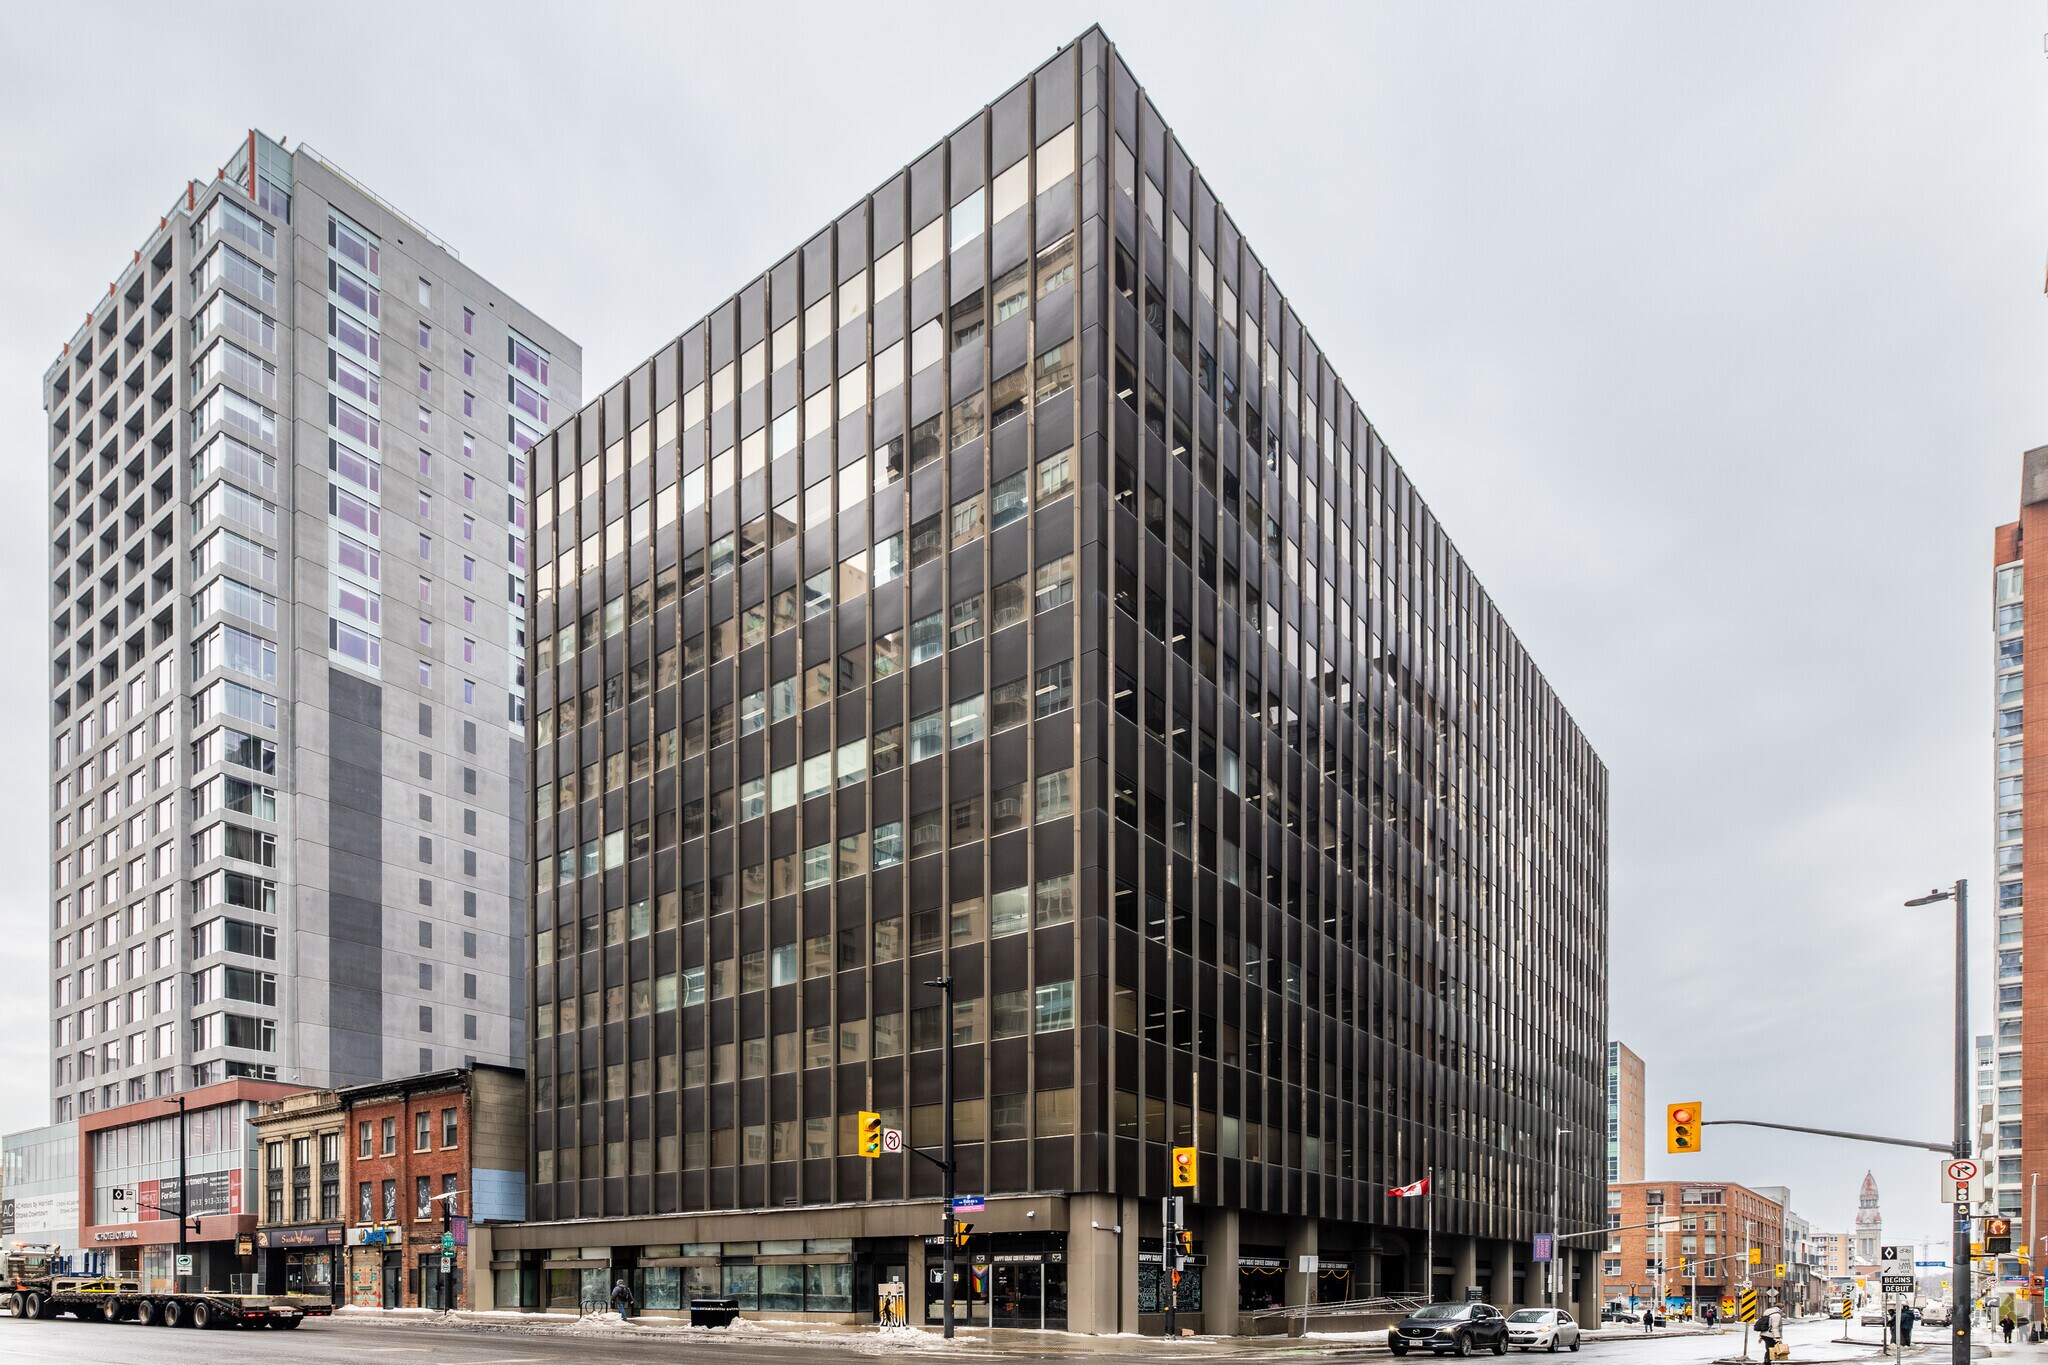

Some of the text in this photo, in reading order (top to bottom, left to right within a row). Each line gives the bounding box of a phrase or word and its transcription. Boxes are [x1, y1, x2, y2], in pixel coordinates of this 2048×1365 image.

[161, 1180, 177, 1189] Luxury
[3, 1204, 13, 1217] AC
[281, 1234, 295, 1244] Sushi
